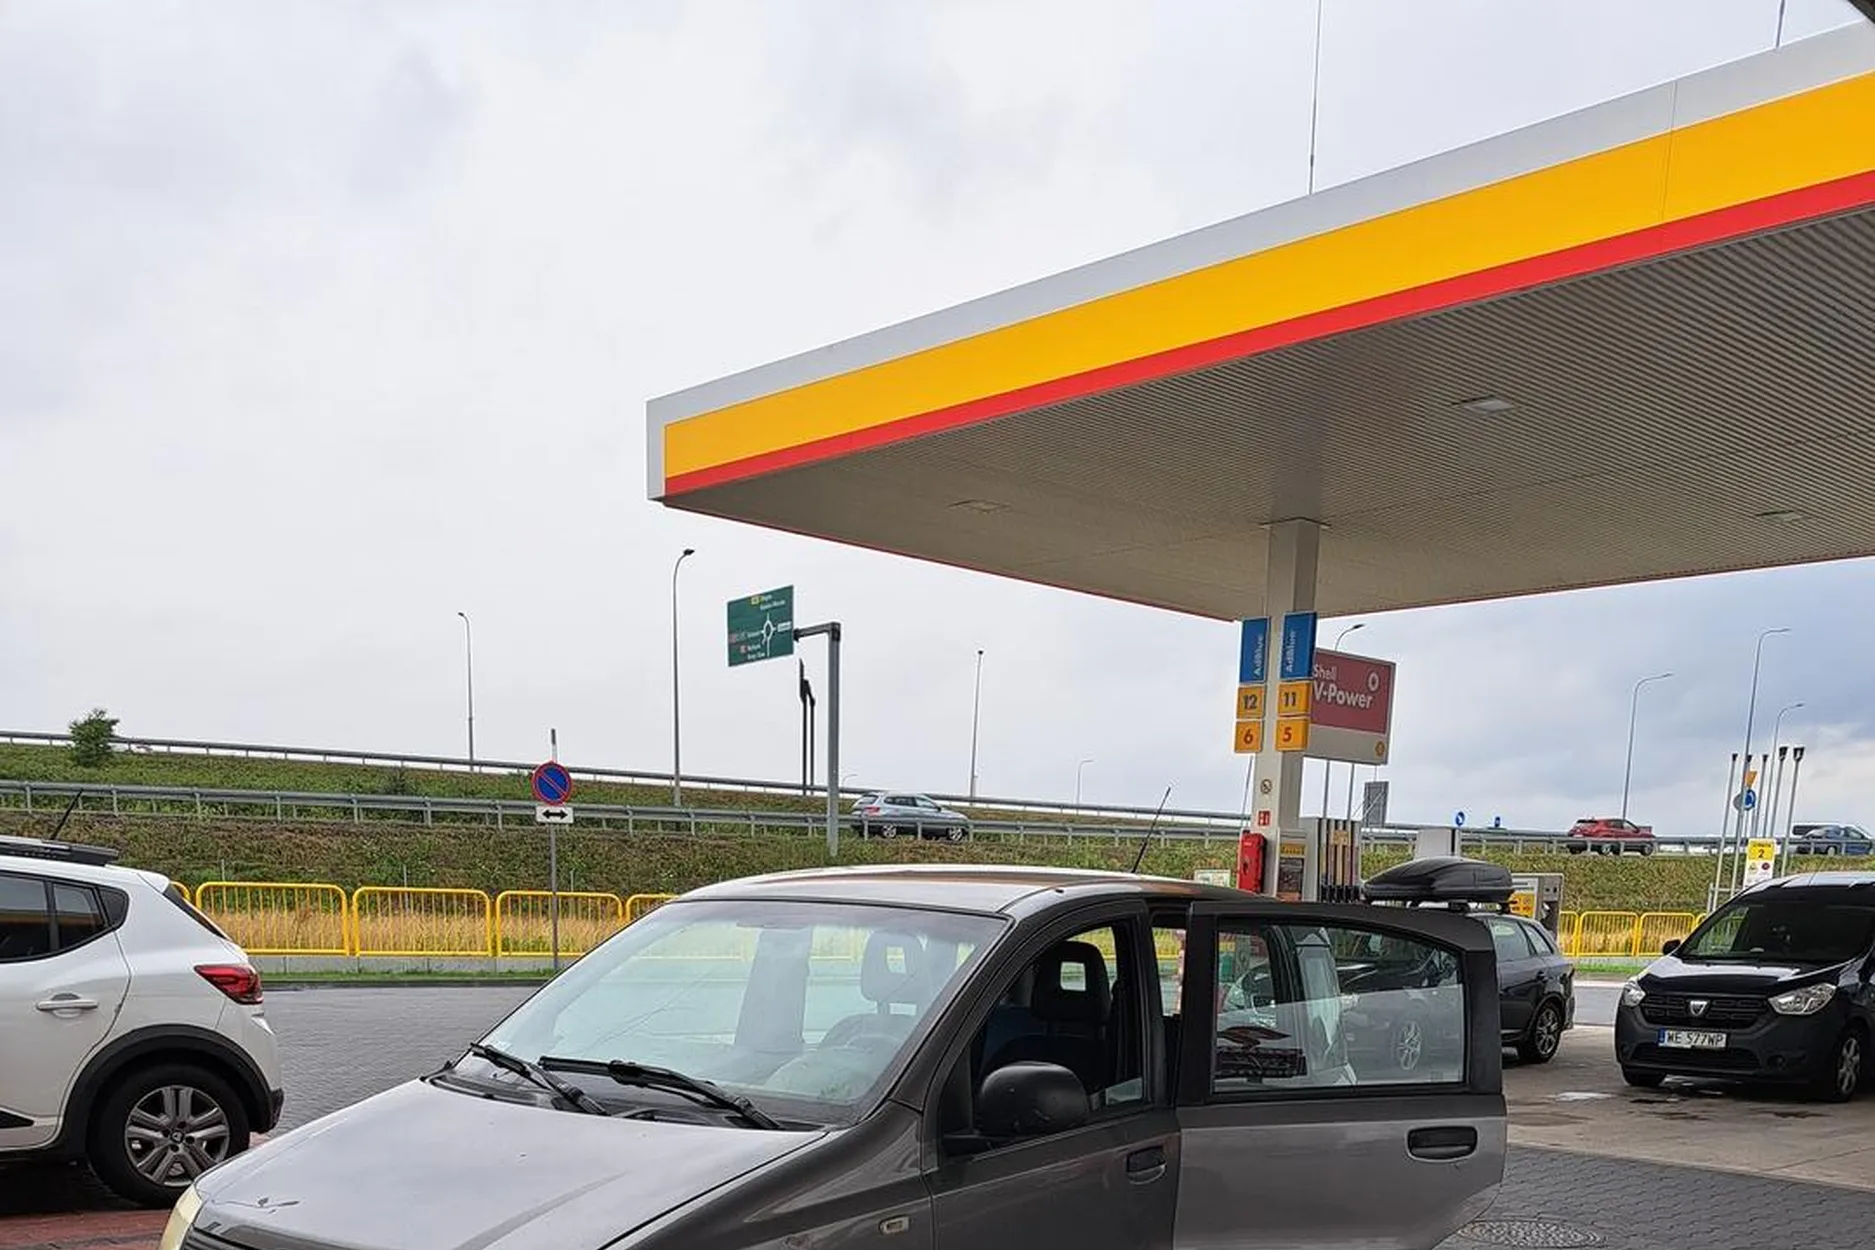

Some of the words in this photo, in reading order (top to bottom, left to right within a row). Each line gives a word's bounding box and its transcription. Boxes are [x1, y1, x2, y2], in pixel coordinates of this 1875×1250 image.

[1313, 664, 1337, 680] Shell
[1243, 694, 1258, 710] 12
[1283, 692, 1297, 708] 11
[1313, 681, 1373, 709] V-Power
[1243, 729, 1254, 745] 6
[1282, 726, 1292, 742] 5
[1667, 1031, 1682, 1044] WE
